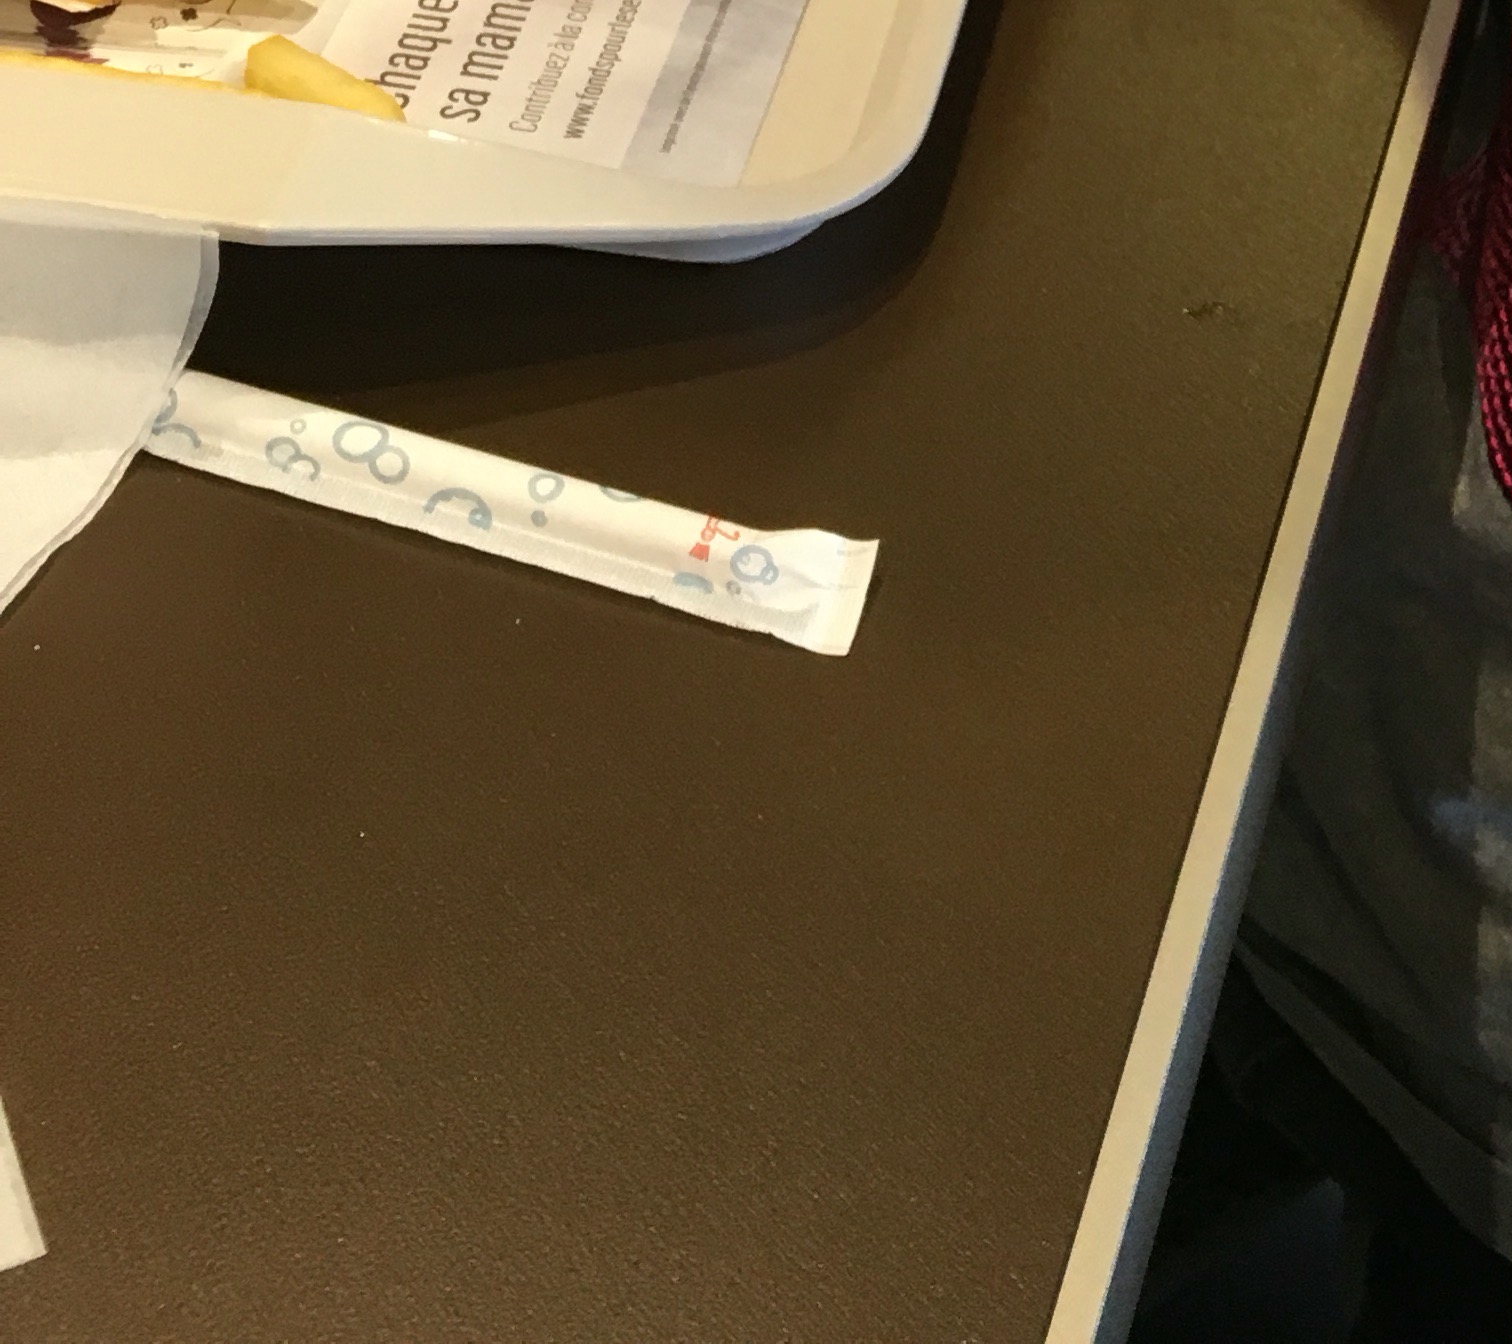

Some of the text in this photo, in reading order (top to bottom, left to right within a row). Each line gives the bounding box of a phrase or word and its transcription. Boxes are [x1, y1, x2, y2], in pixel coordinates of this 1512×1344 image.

[438, 86, 491, 124] sa
[507, 49, 570, 131] Contribuez
[552, 23, 582, 41] la
